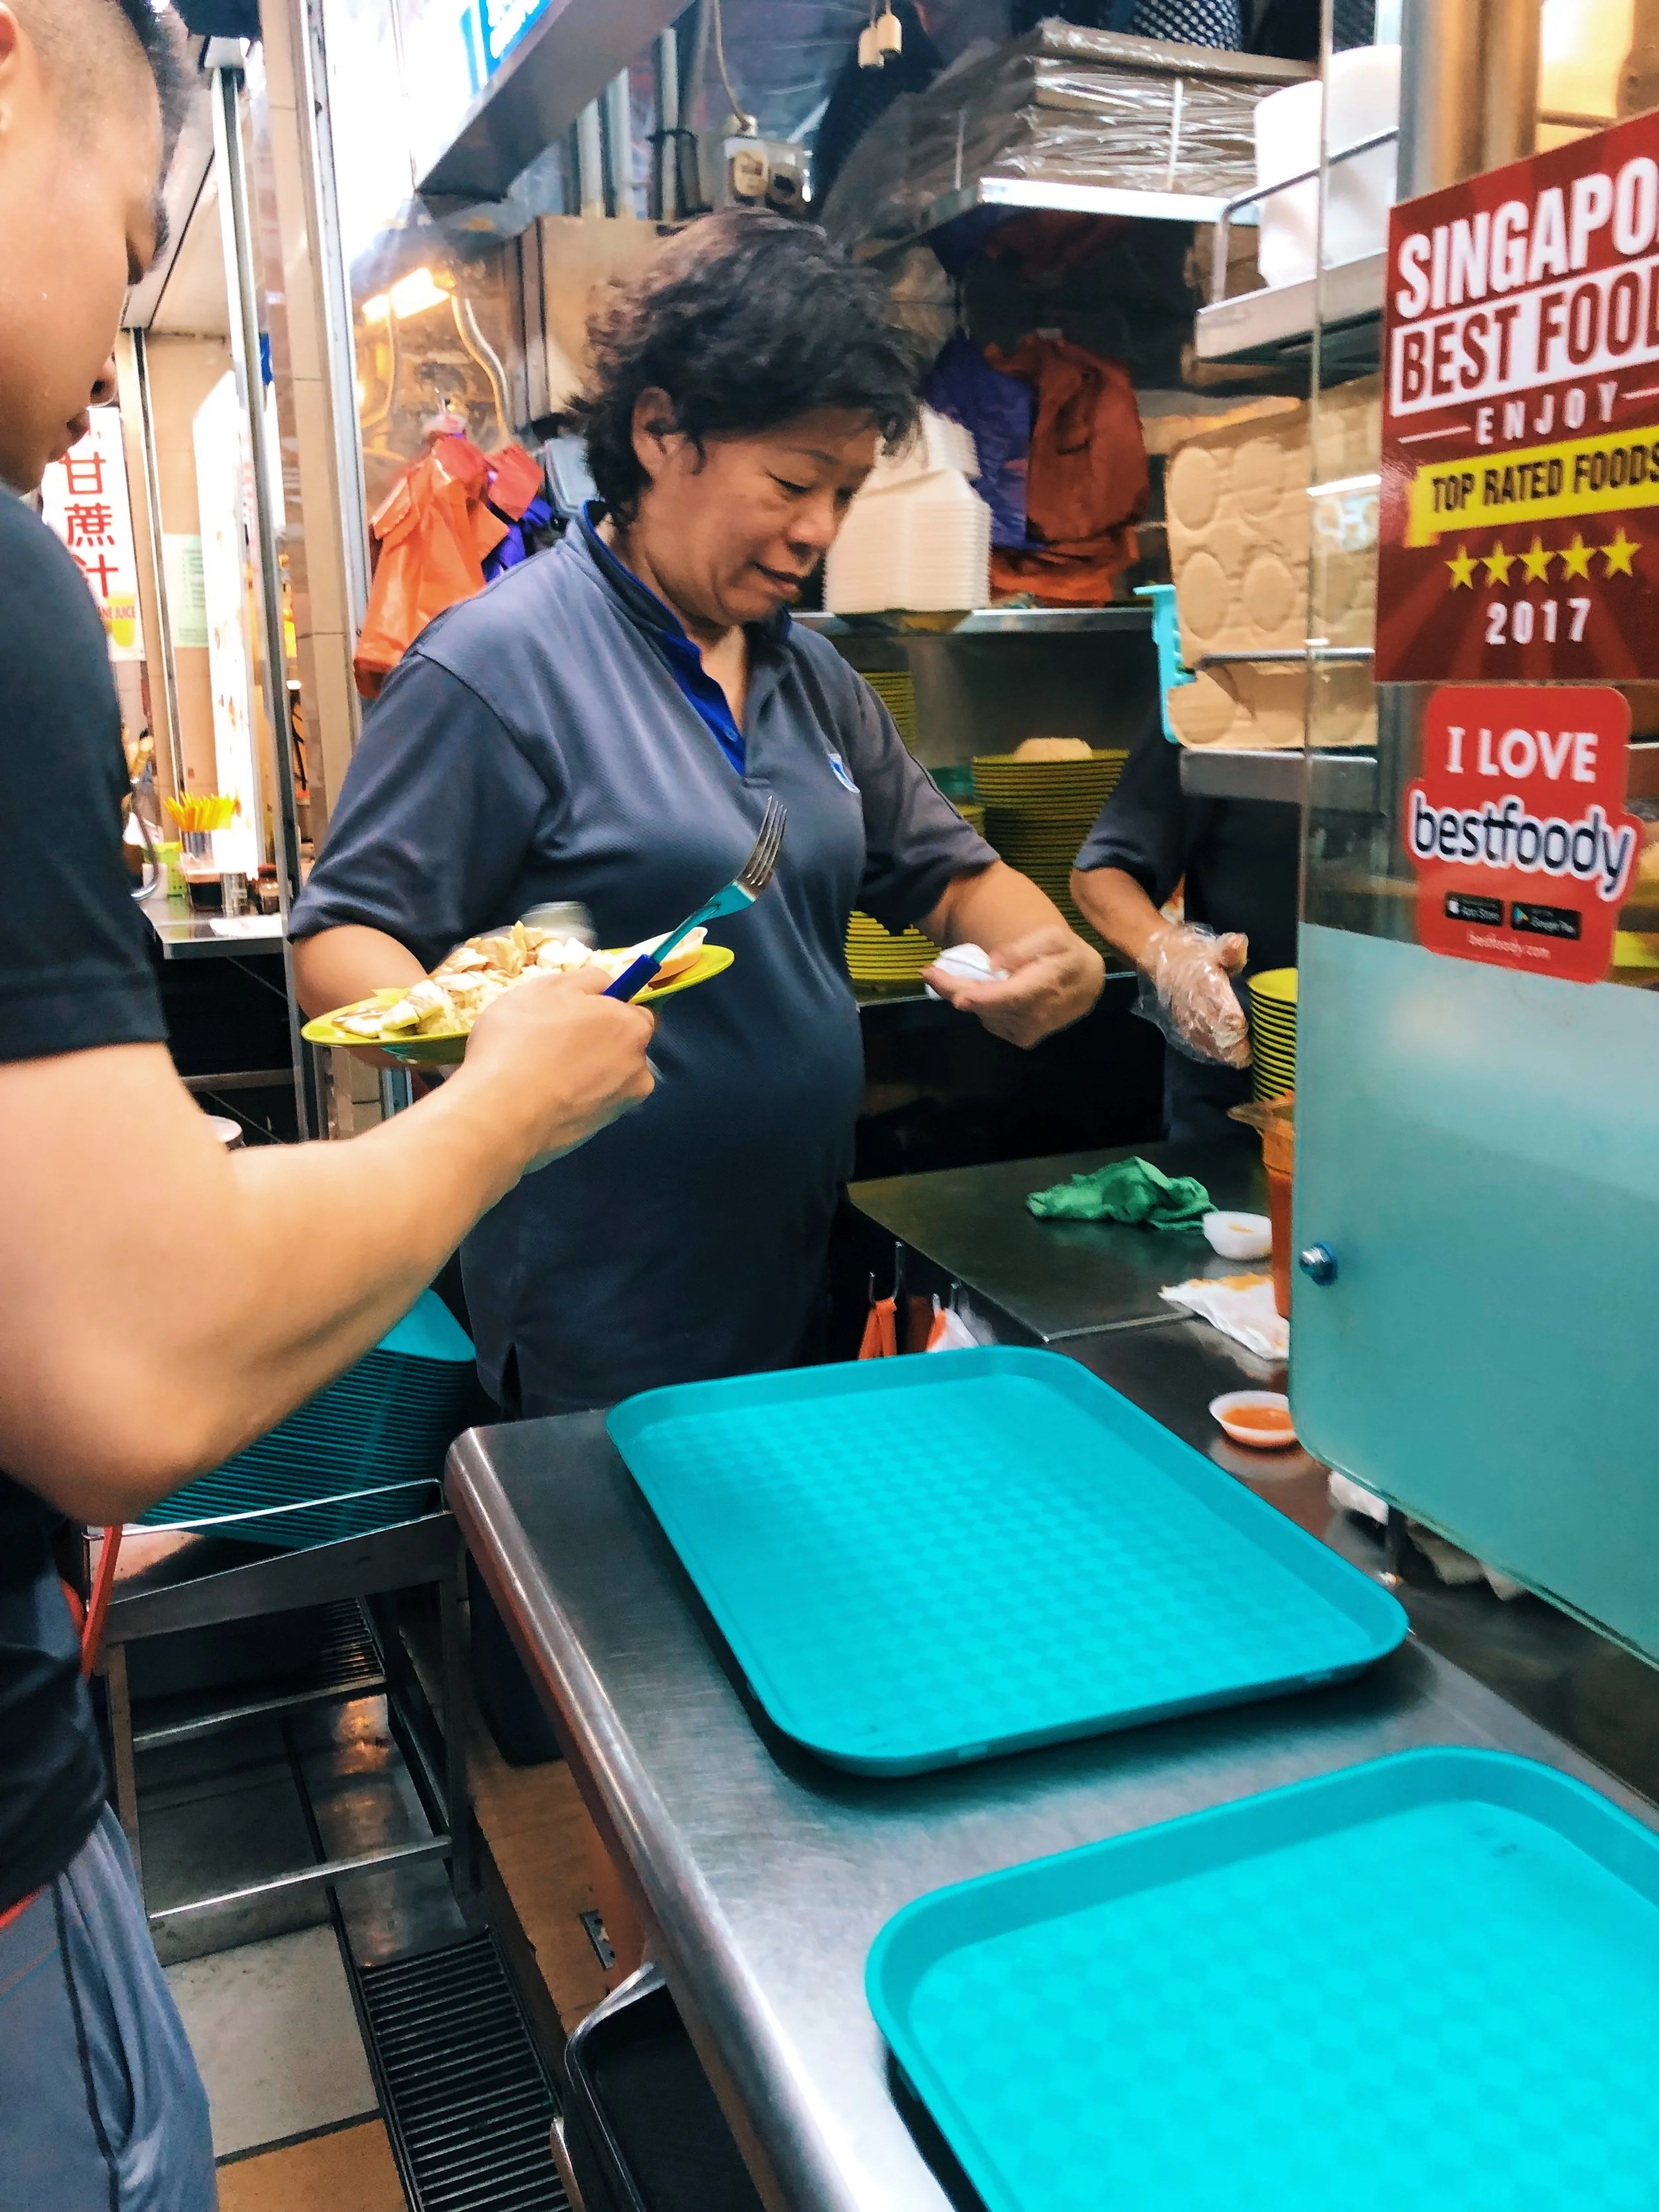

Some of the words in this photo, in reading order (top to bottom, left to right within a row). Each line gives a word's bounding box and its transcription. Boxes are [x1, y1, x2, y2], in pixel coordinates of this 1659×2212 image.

[1396, 156, 1659, 319] SINGAPO
[1399, 303, 1521, 404] BEST
[1476, 380, 1619, 445] ENJOY
[1431, 474, 1475, 513] TOP
[1482, 457, 1564, 506] RATED
[1486, 597, 1591, 645] 2017
[1445, 726, 1466, 774] I
[1479, 728, 1599, 783] LOVE
[1412, 792, 1633, 897] bestfoody
